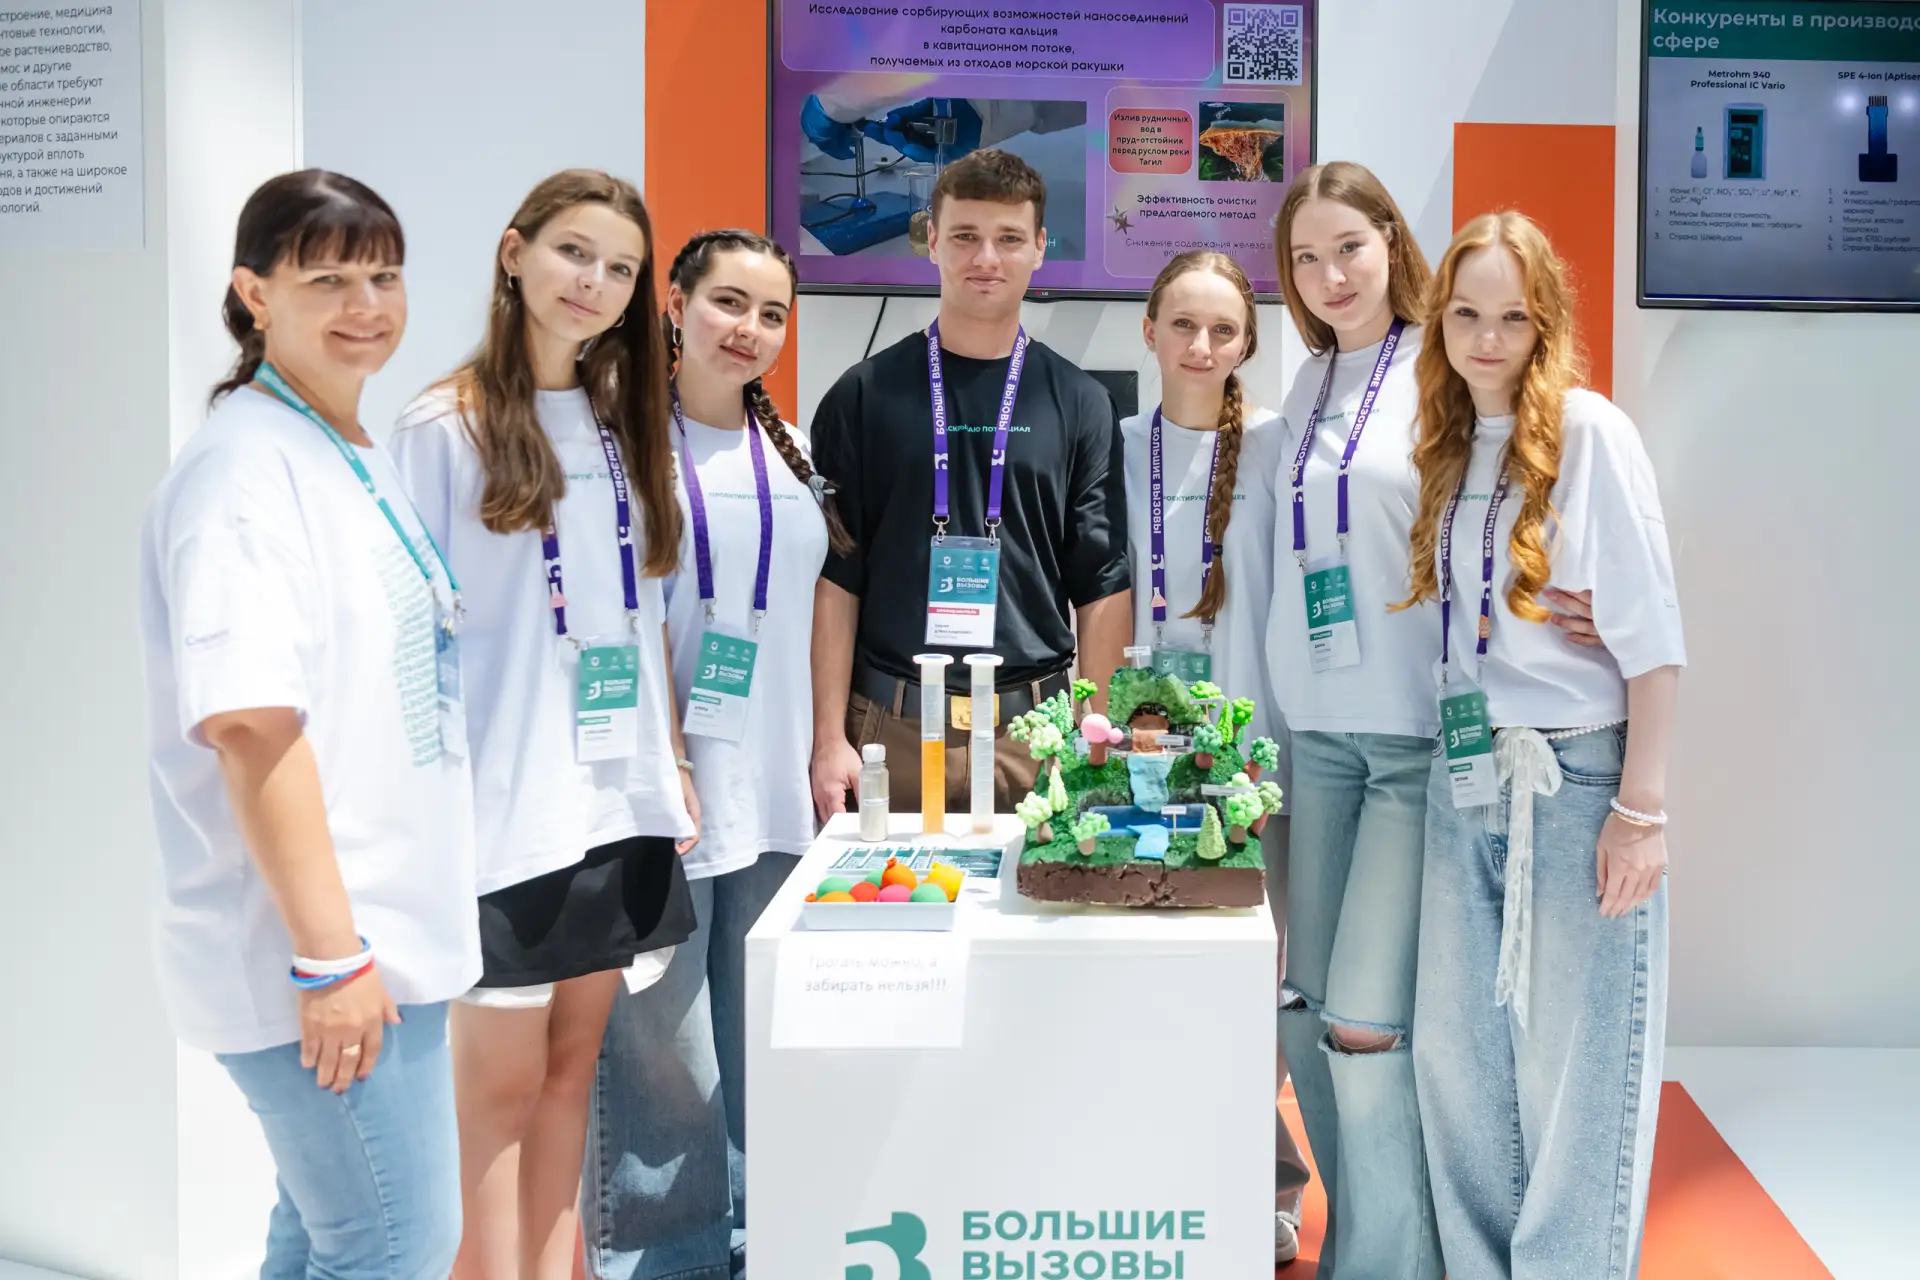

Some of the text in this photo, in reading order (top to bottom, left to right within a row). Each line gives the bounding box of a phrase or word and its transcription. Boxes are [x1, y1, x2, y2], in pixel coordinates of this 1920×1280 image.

[0, 6, 112, 23] строение, медицина
[809, 3, 1189, 24] Исследование сорбирующих возможностей наносоединений
[1654, 8, 1786, 28] Конкуренты
[1792, 16, 1804, 27] в
[40, 24, 105, 37] технологии,
[941, 24, 1058, 37] карбоната кальция
[933, 42, 1028, 52] кавитационном
[1032, 44, 1075, 54] потоке,
[1653, 32, 1720, 52] сфере
[14, 42, 112, 58] растениеводство,
[24, 64, 30, 72] и
[33, 61, 72, 75] другие
[870, 56, 1124, 72] получаемых из отходов морской ракушки
[1708, 70, 1770, 79] Metrohm 940
[1838, 72, 1856, 80] SPE
[11, 78, 54, 91] области
[57, 76, 103, 91] требуют
[1690, 80, 1786, 90] Professional IC Vario
[28, 96, 92, 108] инженерии
[1, 111, 110, 128] которые опираются
[1114, 114, 1188, 124] Излив рудничных
[46, 134, 52, 142] с
[56, 130, 118, 144] заданными
[1116, 136, 1184, 145] пруд-отстойник
[0, 149, 84, 164] уктурой вплоть
[1112, 148, 1137, 156] перед
[1138, 148, 1168, 156] руслом
[18, 170, 24, 178] а
[26, 168, 58, 178] также
[60, 167, 74, 177] на
[76, 166, 128, 178] широкое
[26, 186, 32, 196] и
[34, 182, 102, 196] достижений
[1136, 194, 1214, 205] Эффективность
[0, 201, 42, 213] ологий.
[1140, 209, 1217, 219] предлагаемого
[1126, 238, 1172, 248] Снижение
[1174, 240, 1230, 249] содержания
[930, 336, 944, 435] БОЛЬШИЕ ВЫЗОВЫ
[998, 336, 1024, 431] БОЛЬШИЕ ВЫЗОВЫ
[1350, 334, 1398, 441] БОЛЬШИЕ ВЫЗОВЫ
[604, 441, 626, 502] ВЫЗОВЫ
[1152, 426, 1162, 534] БОЛЬШИЕ ВЫЗОВЫ
[1484, 490, 1504, 558] БОЛЬШИЕ
[805, 974, 946, 996] забирать нельзя!!!
[962, 1210, 1205, 1241] БОЛЬШИЕ
[962, 1250, 1184, 1280] ВЫЗОВЫ
